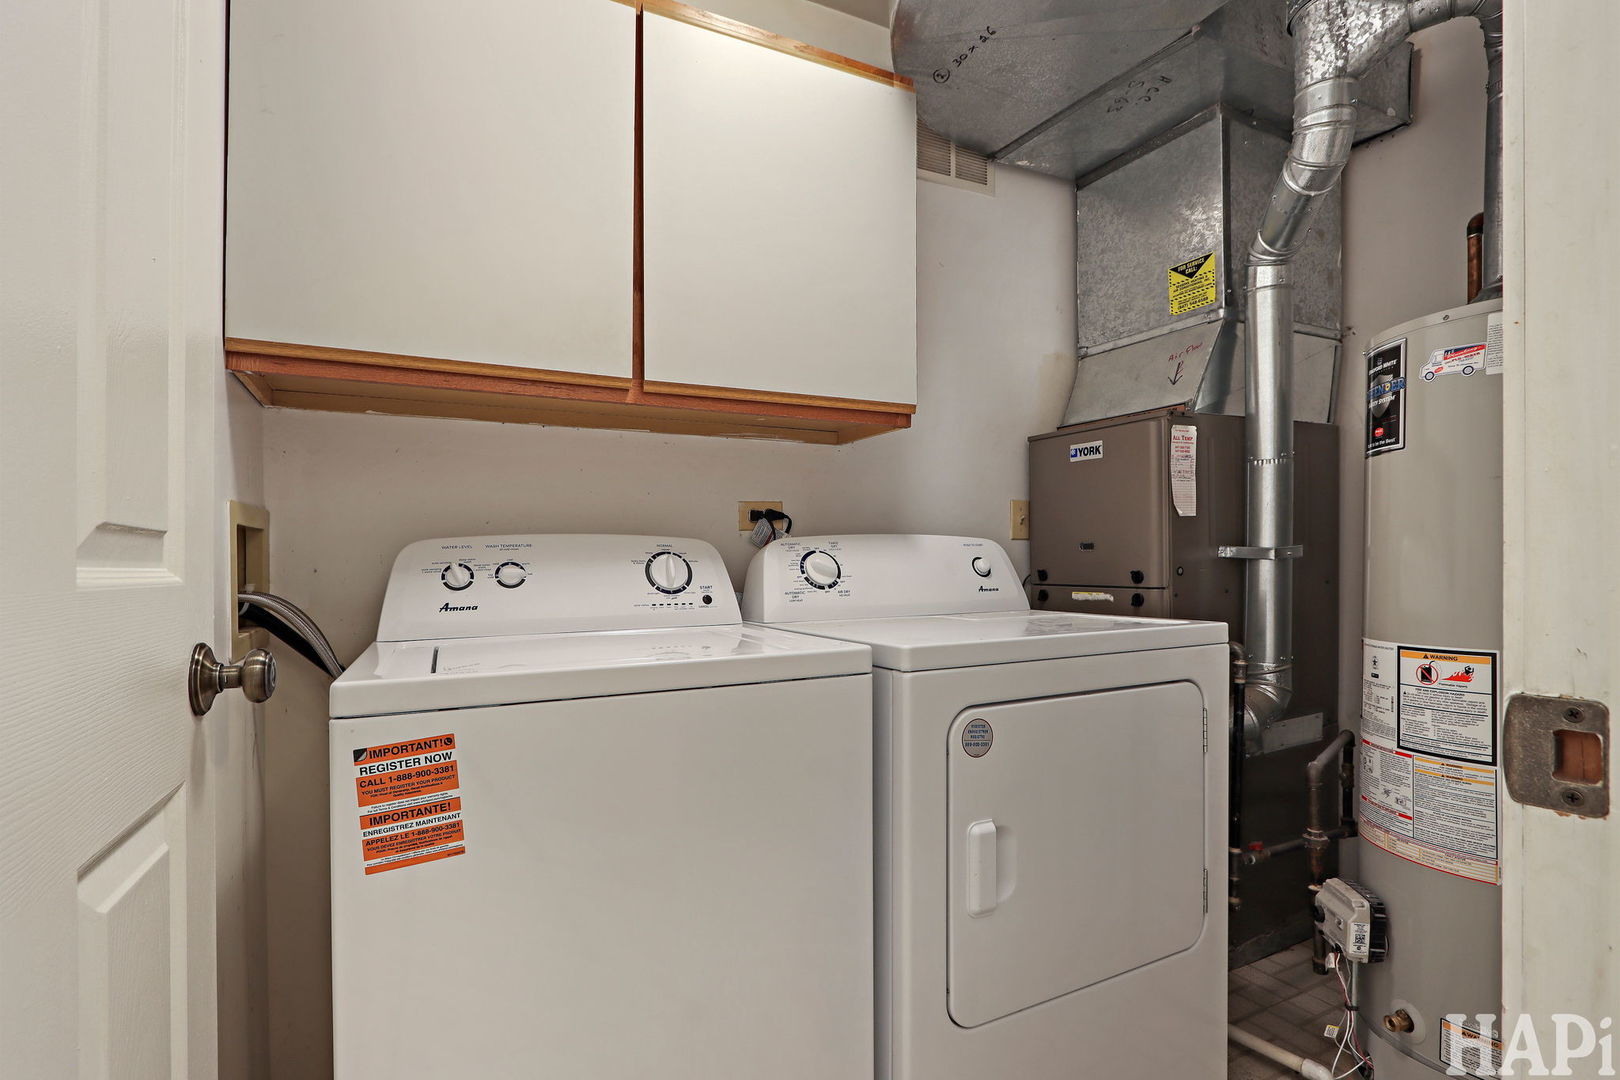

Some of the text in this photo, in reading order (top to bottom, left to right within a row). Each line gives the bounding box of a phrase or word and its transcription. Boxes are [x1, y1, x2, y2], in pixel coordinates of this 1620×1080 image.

[952, 54, 968, 68] 30
[980, 26, 996, 43] 26
[1077, 445, 1102, 457] YORK
[439, 602, 478, 613] Amana
[369, 739, 443, 759] IMPORTANT!
[360, 752, 453, 776] REGISTER NOW
[360, 765, 454, 788] CALL 1-888-900-3381
[390, 782, 415, 790] REGISTER
[363, 812, 461, 838] ENREGISTREZ MAINTENANT
[369, 802, 451, 826] IMPORTANTE!
[365, 835, 400, 846] APPELEZ
[411, 823, 460, 837] 1-888-900-3381
